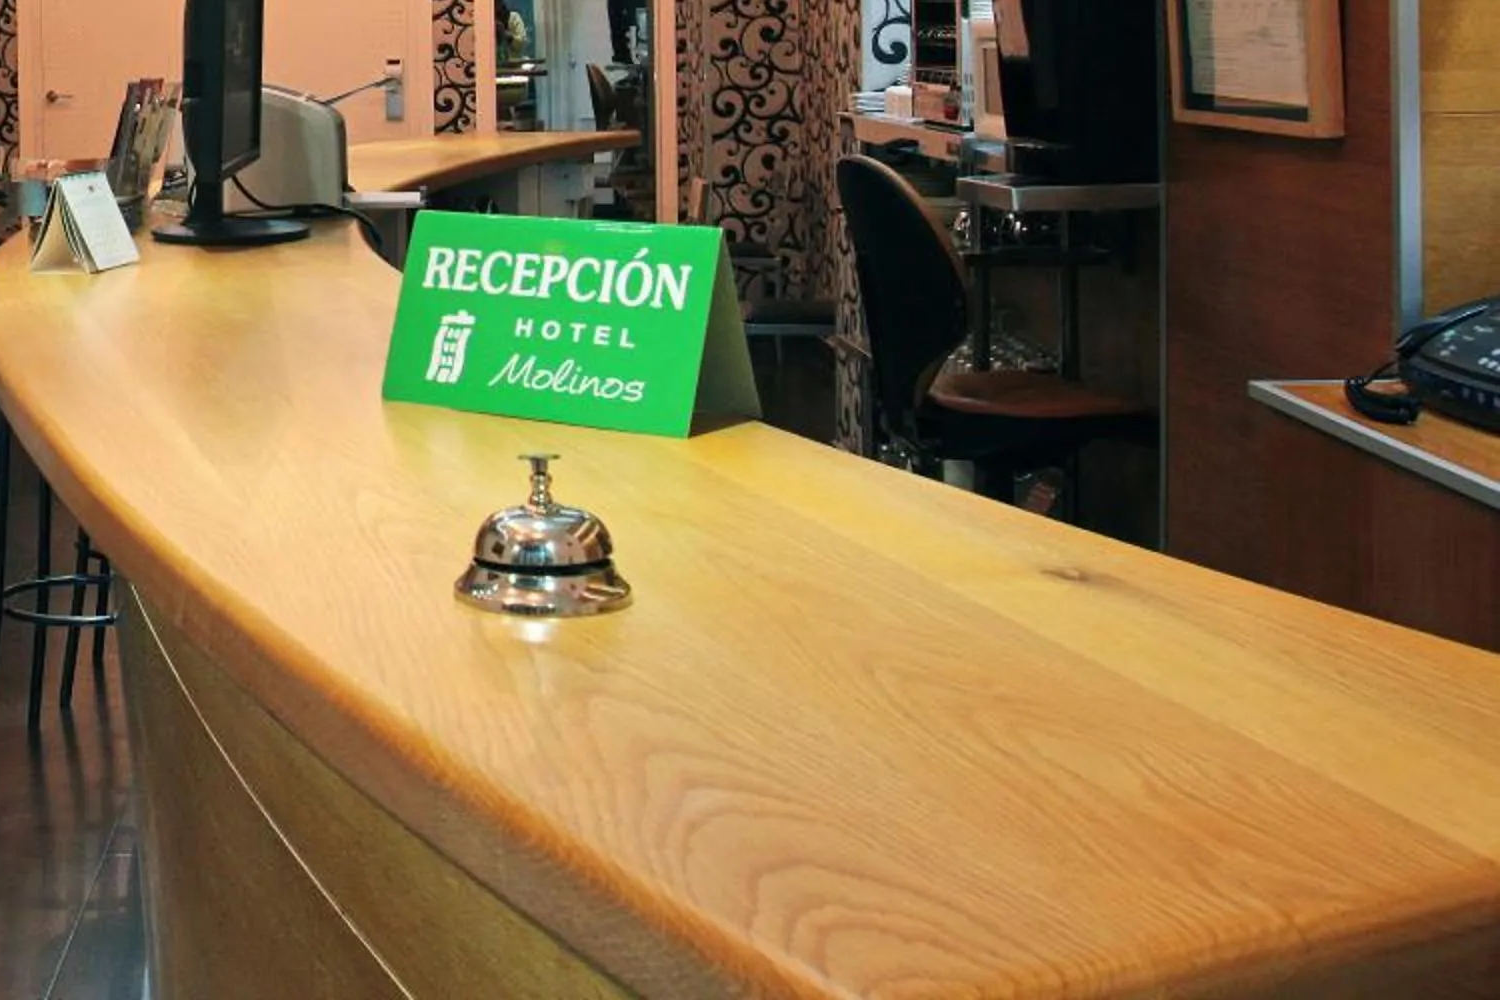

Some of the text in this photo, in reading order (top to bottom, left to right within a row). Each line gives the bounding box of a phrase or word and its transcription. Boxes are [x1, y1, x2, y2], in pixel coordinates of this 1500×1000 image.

[423, 247, 692, 310] RECEPCIÓN
[515, 318, 636, 348] HOTEL
[489, 354, 645, 402] Molinos
